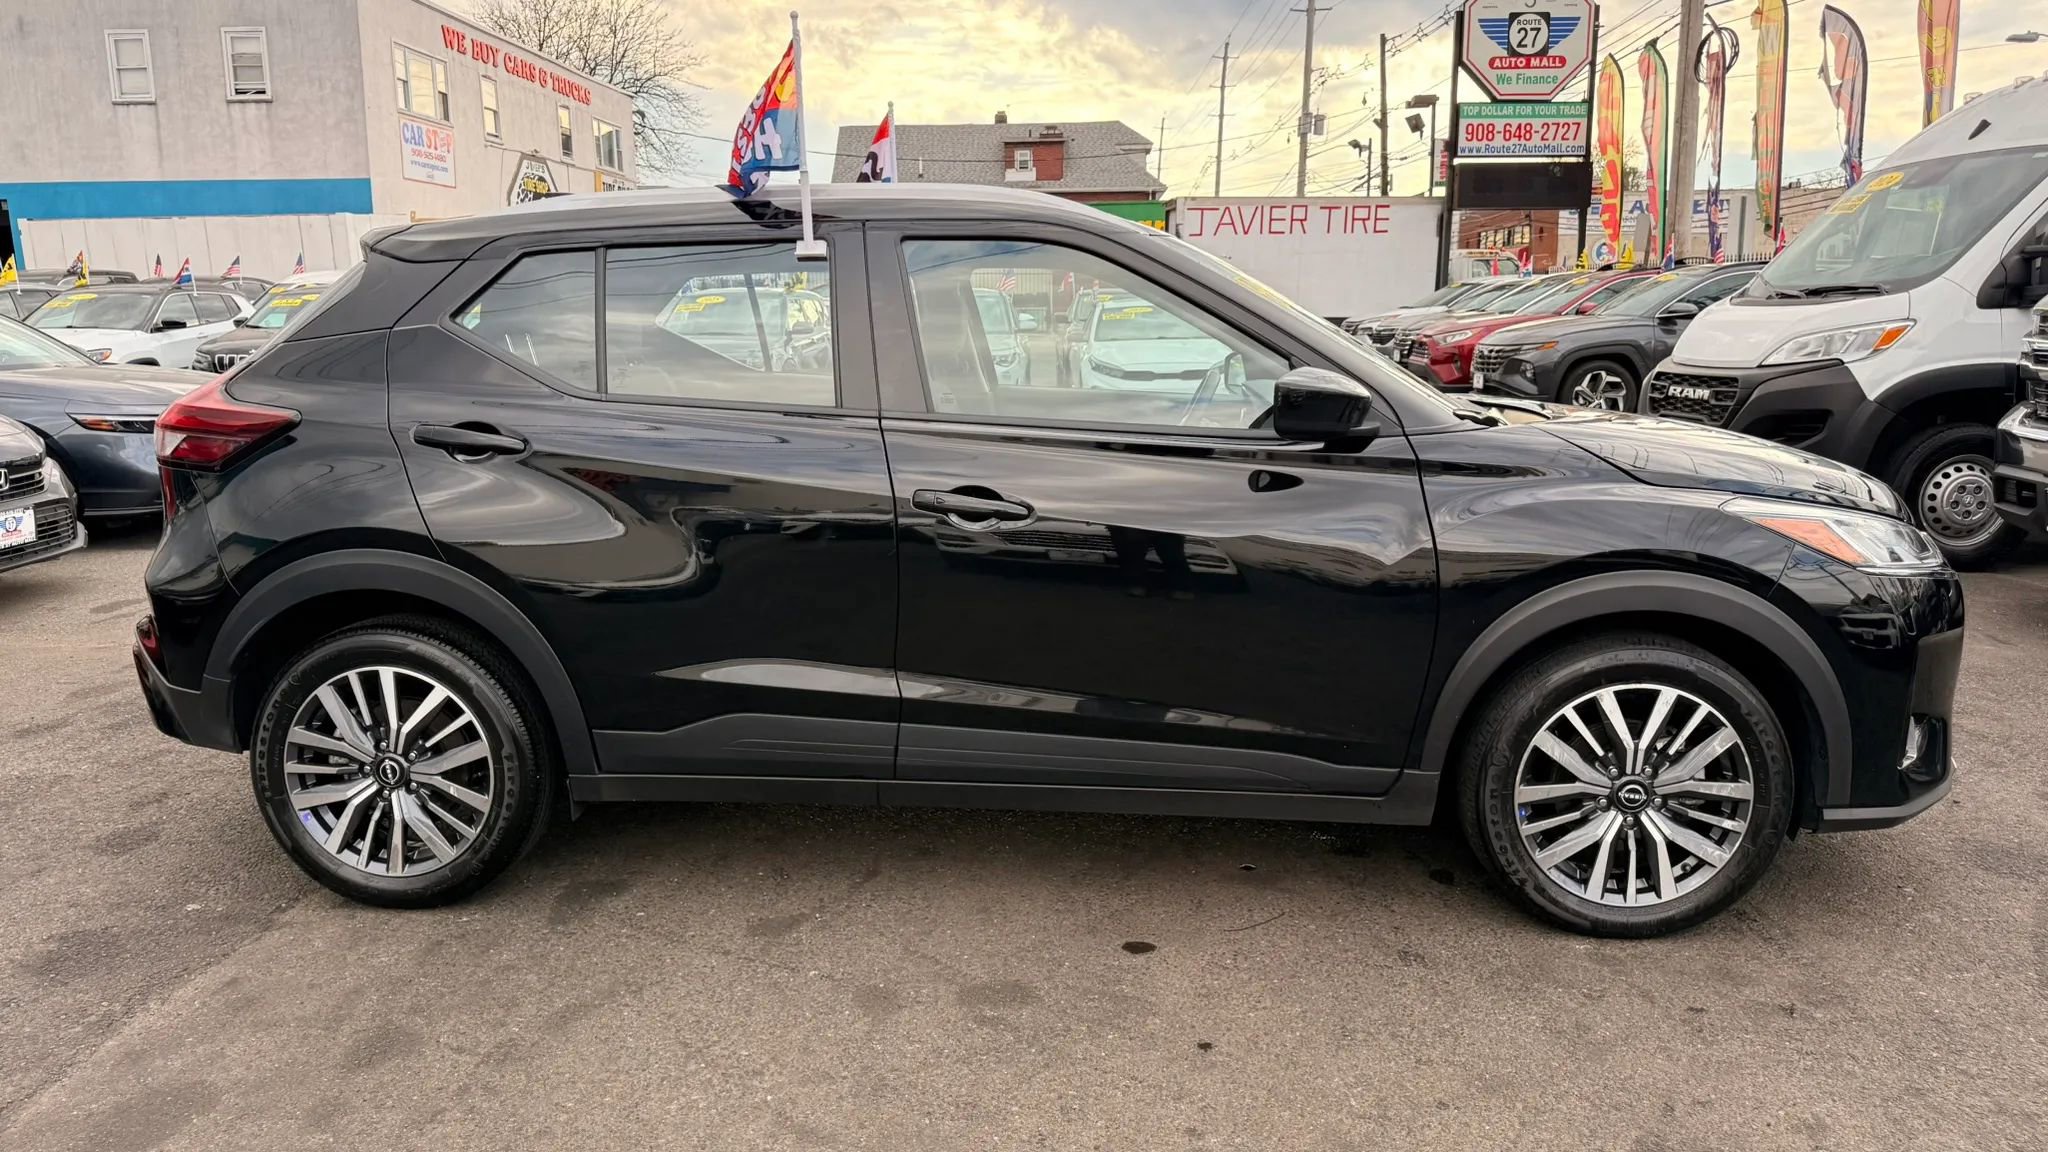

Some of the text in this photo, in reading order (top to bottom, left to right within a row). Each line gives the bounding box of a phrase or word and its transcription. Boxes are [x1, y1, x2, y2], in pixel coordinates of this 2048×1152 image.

[1516, 27, 1542, 49] 27
[441, 24, 467, 55] WE
[471, 38, 500, 68] BUY
[504, 52, 537, 83] CARS
[550, 71, 592, 106] TRUCKS
[1493, 57, 1562, 68] AUTO MALL
[1496, 73, 1559, 85] We Finance
[1463, 105, 1587, 116] TOP DOLLAR FOR YOUR TRADE
[402, 122, 425, 147] CAR
[1465, 122, 1581, 142] 908-648-2727
[1459, 143, 1585, 155] www.Route27AutoMall.com
[1187, 204, 1390, 237] JAVIER TIRE
[1668, 386, 1711, 400] RAM
